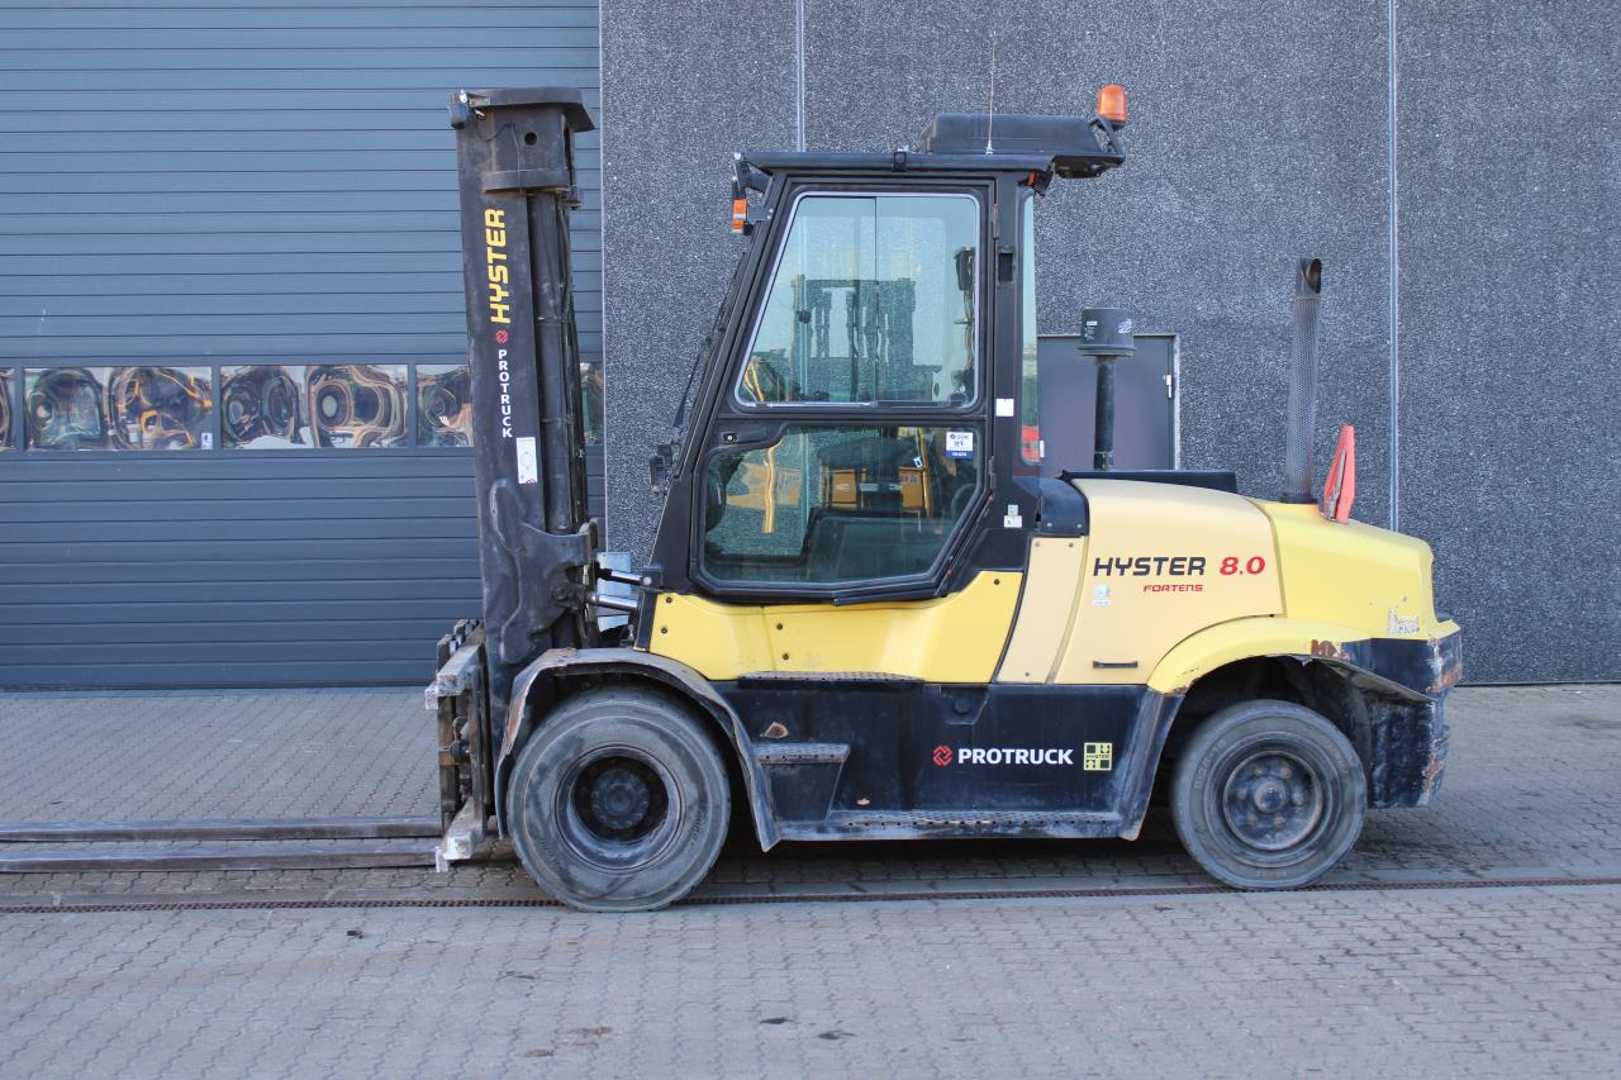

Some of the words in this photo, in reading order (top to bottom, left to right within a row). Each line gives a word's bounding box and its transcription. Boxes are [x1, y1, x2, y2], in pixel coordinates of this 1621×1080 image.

[484, 208, 511, 325] HYSTER
[498, 349, 513, 438] PROTRUCK
[1093, 556, 1207, 577] HYSTER
[1219, 556, 1266, 576] 8.0
[1143, 584, 1204, 592] FORTENS
[958, 748, 1074, 765] PROTRUCK
